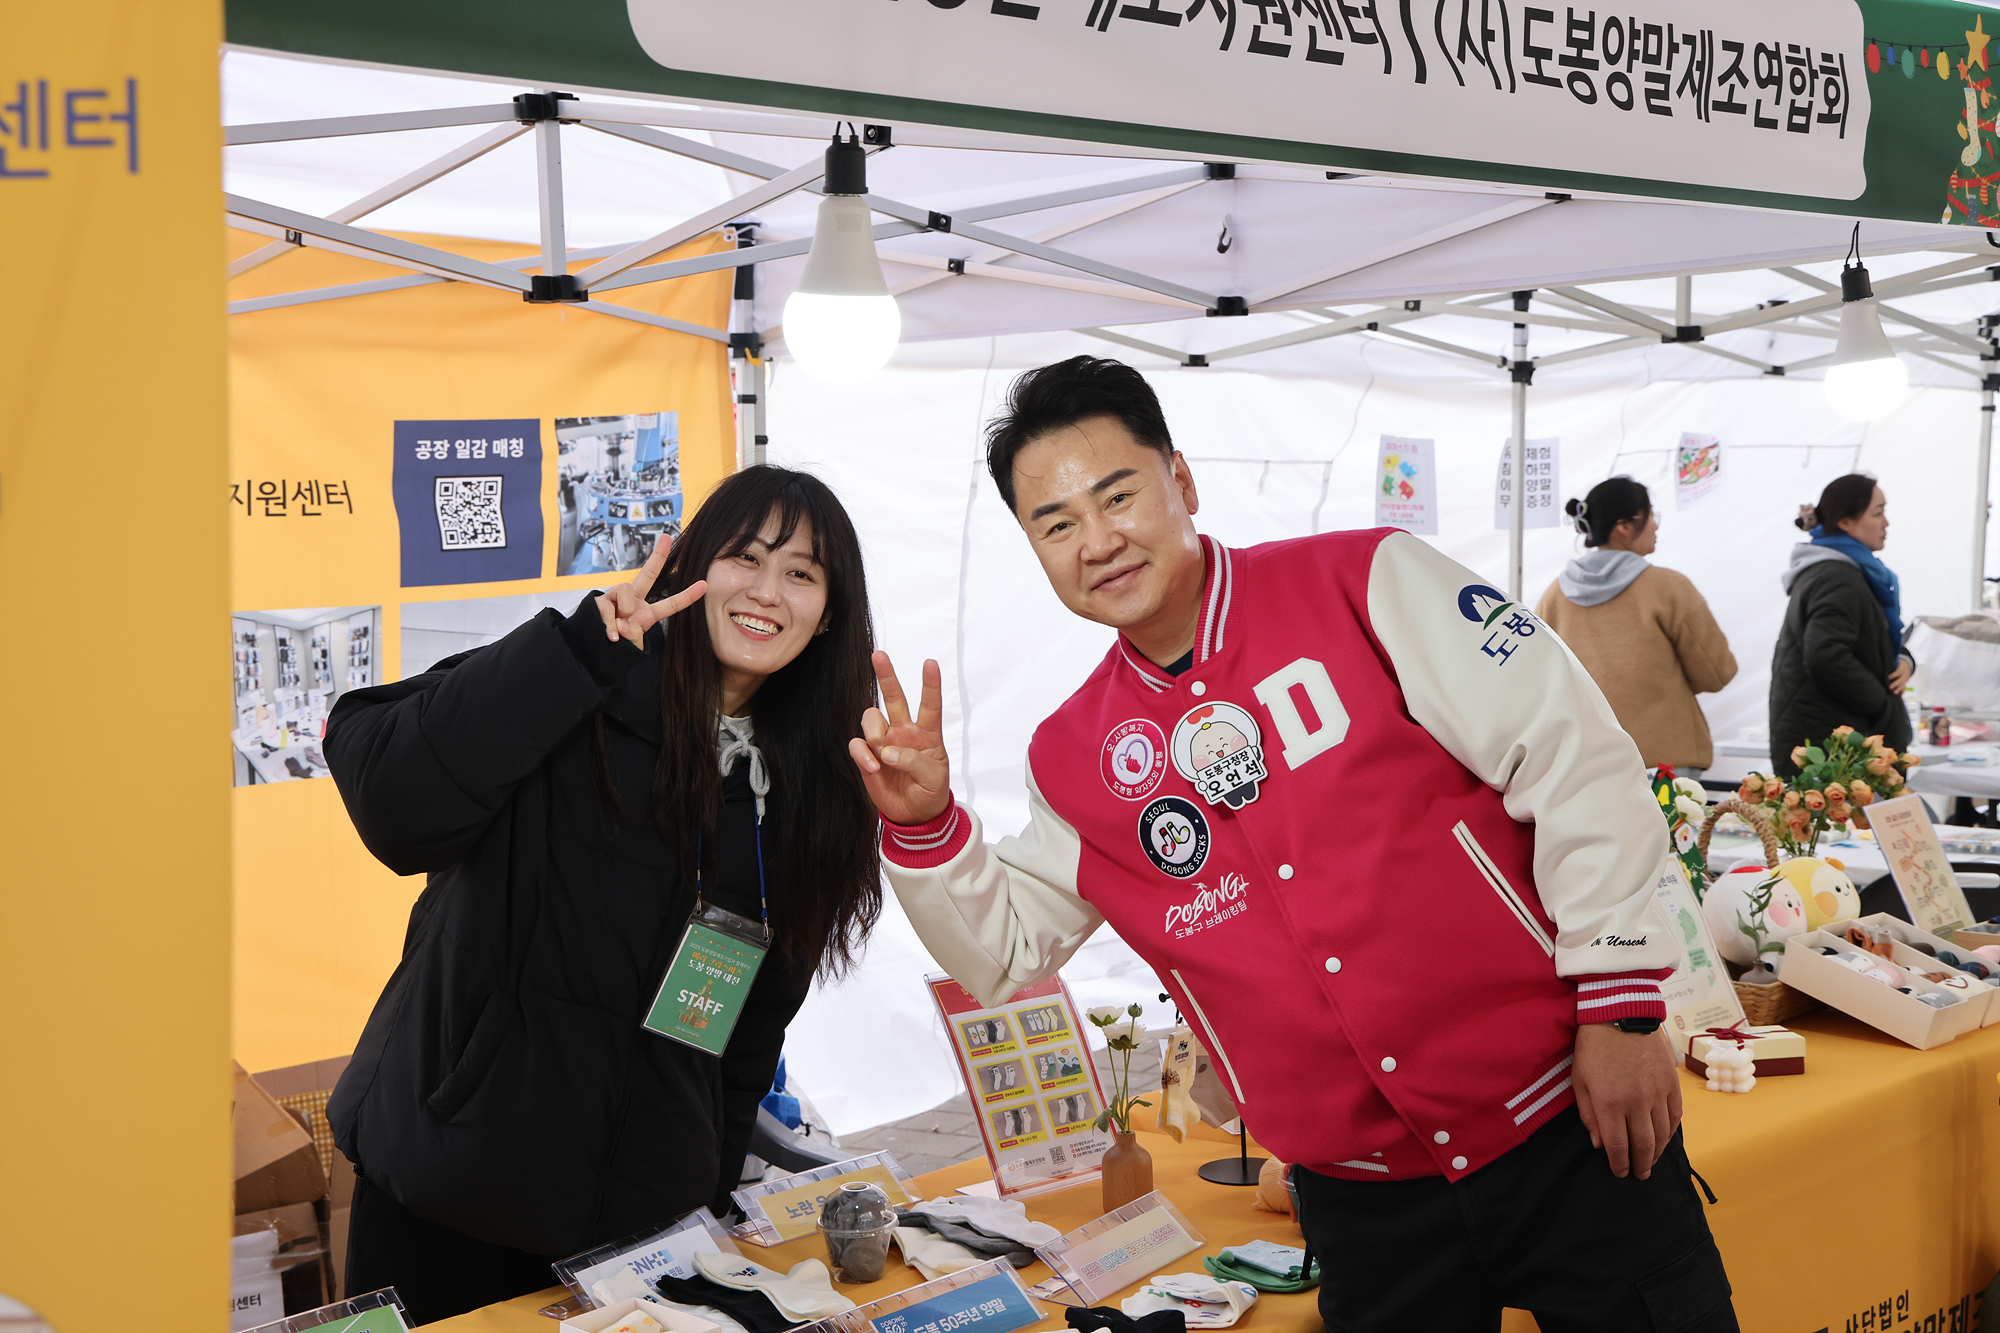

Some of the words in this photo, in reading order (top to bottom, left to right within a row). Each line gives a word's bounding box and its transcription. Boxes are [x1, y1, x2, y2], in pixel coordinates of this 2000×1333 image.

[415, 440, 450, 460] 공장
[454, 439, 488, 459] 일감
[492, 437, 525, 458] 매칭
[1253, 657, 1351, 771] D
[1204, 750, 1249, 780] 도봉구청장
[1145, 802, 1171, 824] SEOUL
[1161, 862, 1195, 875] DOBONG
[1193, 834, 1207, 865] SOCKS
[1175, 922, 1204, 940] 도봉구
[1205, 899, 1248, 929] 브레이킹팀
[1605, 935, 1647, 947] Unseok
[687, 959, 705, 972] 도봉
[722, 972, 741, 987] 대전
[691, 951, 708, 963] 미리
[707, 957, 743, 977] 크리스마스
[677, 989, 724, 1015] STAFF
[785, 1199, 817, 1220] 노란
[1080, 1260, 1106, 1280] 양말
[1098, 1247, 1131, 1271] 디자인
[1123, 1235, 1155, 1259] 공모전
[1148, 1222, 1180, 1246] 선정작
[940, 1307, 983, 1333] 50주년
[980, 1297, 1007, 1317] 양말
